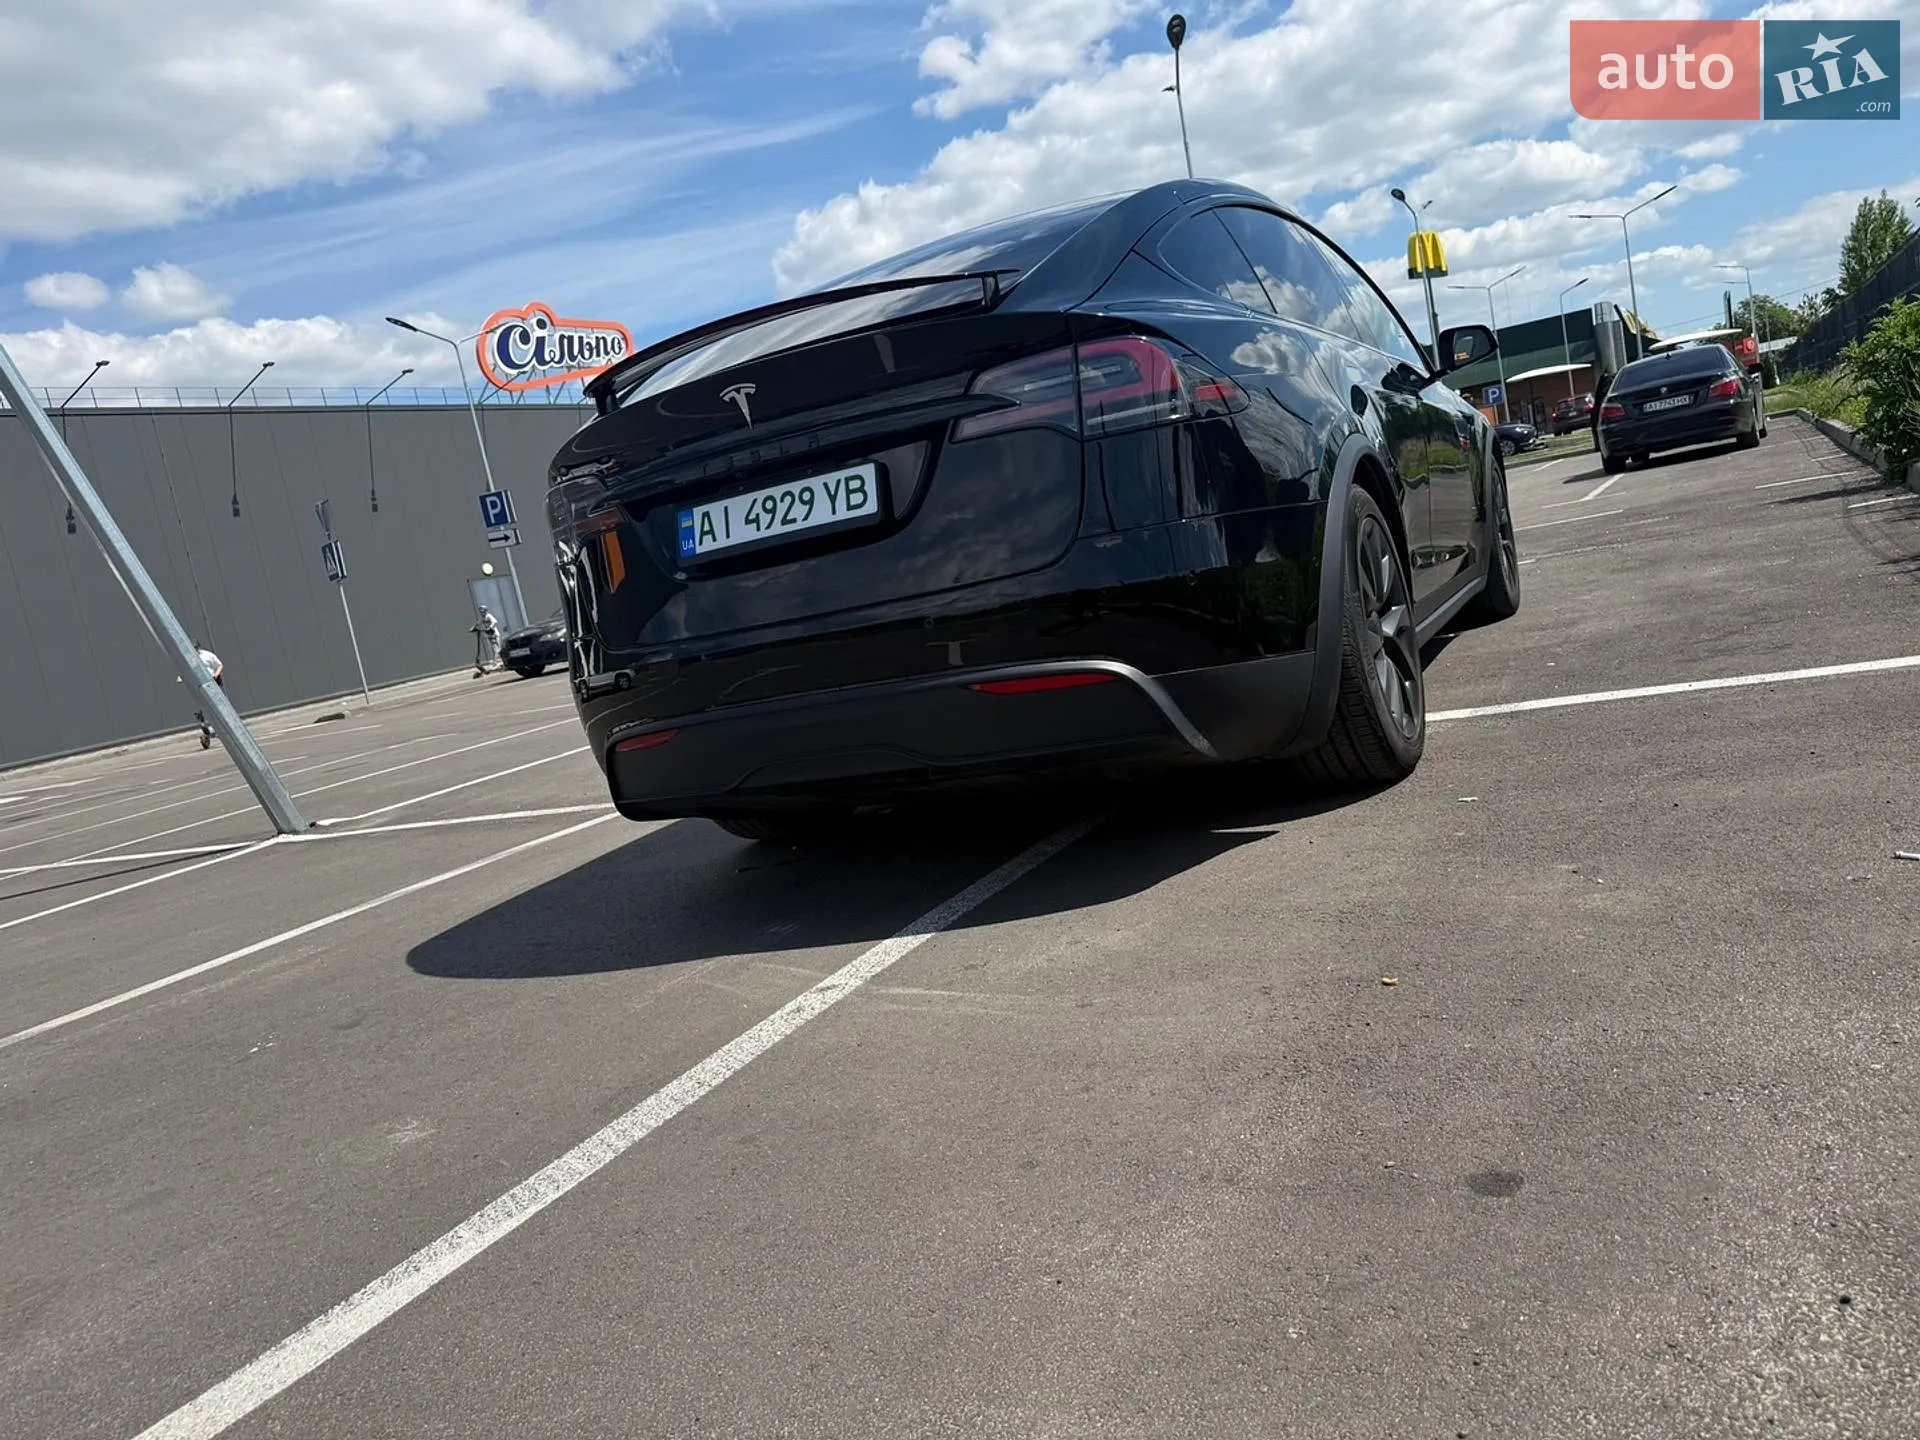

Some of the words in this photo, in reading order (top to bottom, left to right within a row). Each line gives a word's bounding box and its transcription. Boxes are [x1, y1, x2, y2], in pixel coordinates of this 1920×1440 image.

[495, 317, 624, 371] Сільпо
[1487, 389, 1500, 404] P
[485, 496, 501, 524] P
[698, 505, 731, 546] AI
[744, 486, 816, 532] 4929
[822, 474, 869, 516] YB
[682, 540, 695, 550] UA
